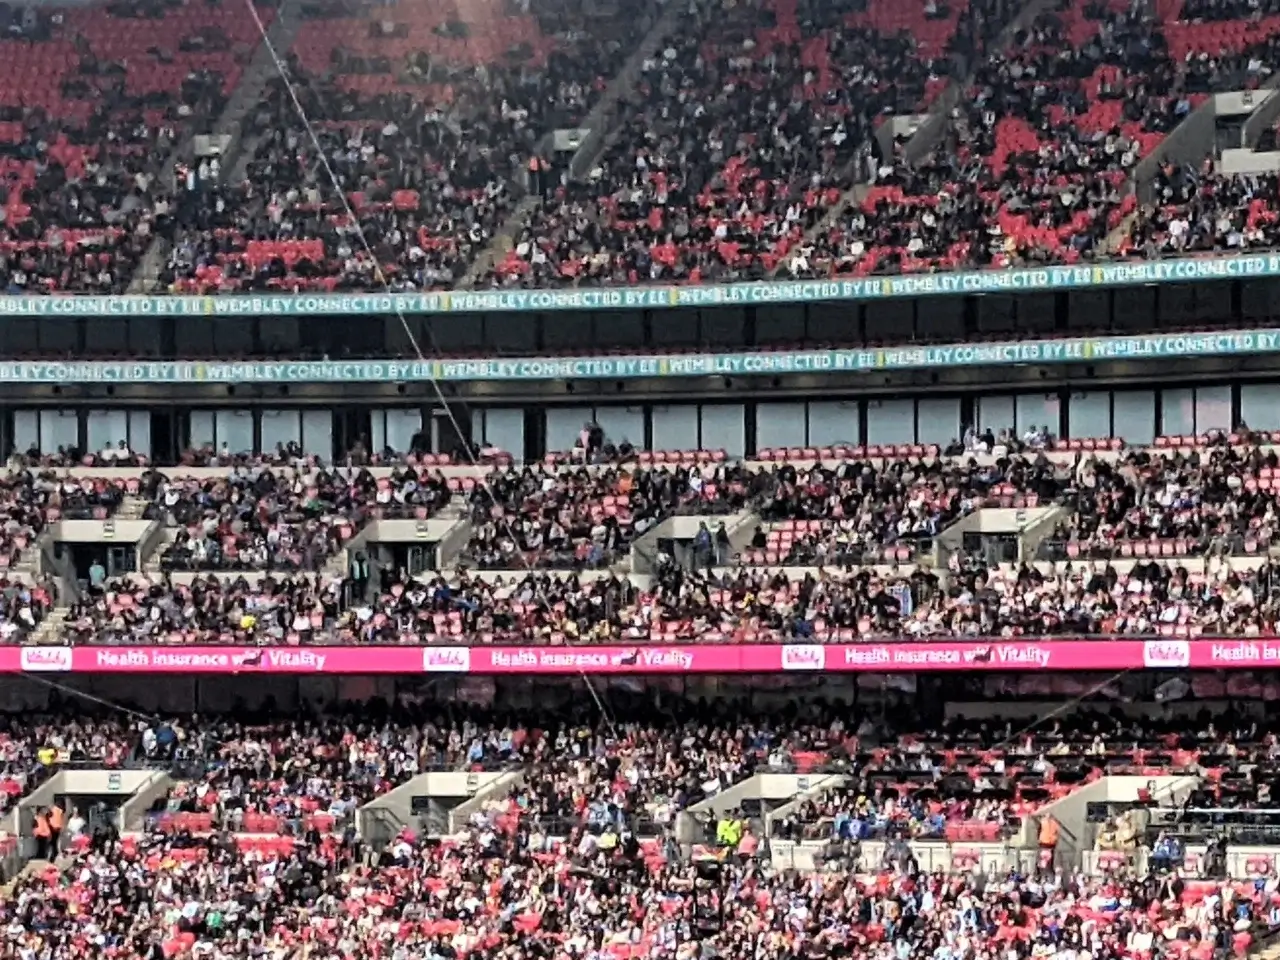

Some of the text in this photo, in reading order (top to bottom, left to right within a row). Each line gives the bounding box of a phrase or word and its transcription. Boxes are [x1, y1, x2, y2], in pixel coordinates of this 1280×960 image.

[1103, 265, 1172, 282] WEMBLEY
[1176, 259, 1264, 278] CONNECTED
[893, 277, 960, 294] WEMBLEY
[964, 272, 1047, 290] CONNECTED
[1053, 271, 1071, 285] BY
[451, 293, 526, 309] WEMBLEY
[529, 291, 620, 307] CONNECTED
[627, 290, 644, 305] BY
[678, 286, 750, 303] WEMBLEY
[752, 283, 838, 300] CONNECTED
[844, 282, 860, 296] BY
[52, 298, 152, 312] CONNECTED
[157, 298, 183, 312] BY
[216, 297, 290, 311] WEMBLEY
[295, 296, 390, 311] CONNECTED
[396, 295, 415, 310] BY
[886, 350, 950, 366] WEMBLEY
[955, 346, 1038, 363] CONNECTED
[1044, 345, 1060, 359] BY
[1094, 340, 1162, 357] WEMBLEY
[1166, 336, 1251, 354] CONNECTED
[1257, 335, 1276, 349] BY
[46, 365, 144, 379] CONNECTED
[150, 366, 170, 379] BY
[208, 366, 284, 378] WEMBLEY
[288, 365, 383, 378] CONNECTED
[388, 365, 408, 377] BY
[443, 363, 518, 377] WEMBLEY
[522, 361, 608, 376] CONNECTED
[612, 360, 638, 374] BY
[670, 358, 741, 373] WEMBLEY
[744, 355, 830, 371] CONNECTED
[836, 354, 854, 368] BY
[97, 650, 148, 665] Health
[153, 650, 228, 665] insurance
[270, 649, 327, 669] Vitality
[491, 651, 537, 666] Health
[540, 651, 609, 666] insurance
[643, 649, 693, 668] Vitality
[845, 648, 889, 663] Health
[893, 648, 960, 664] insurance
[998, 646, 1050, 665] Vitality
[1212, 644, 1259, 660] Health
